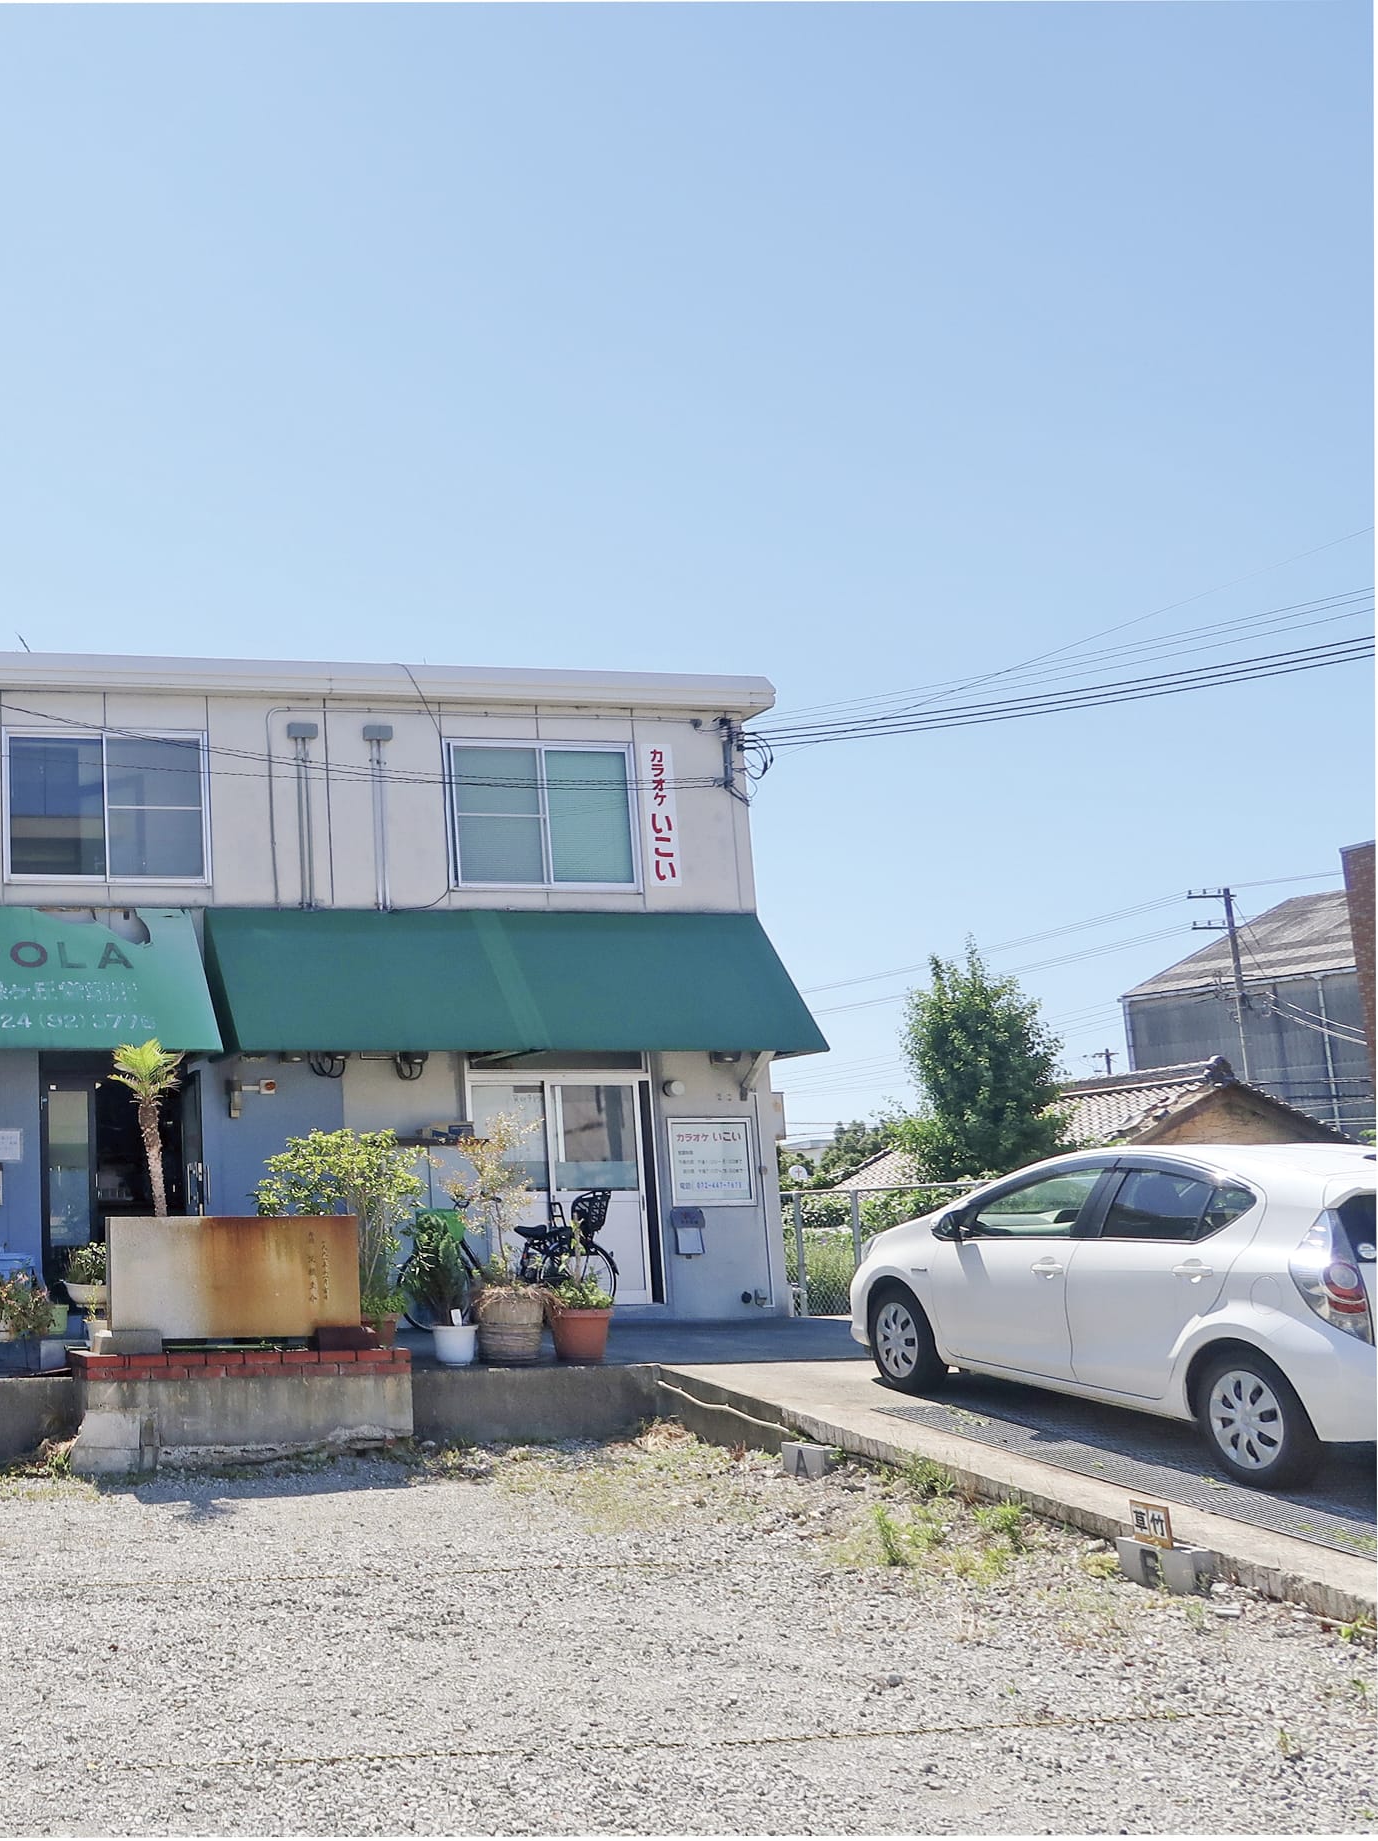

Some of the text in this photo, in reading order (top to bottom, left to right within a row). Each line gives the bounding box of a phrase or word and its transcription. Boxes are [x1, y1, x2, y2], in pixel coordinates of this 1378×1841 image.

[650, 749, 676, 881] カラオケ いこい
[676, 1131, 741, 1142] カラオケ いこい
[795, 1449, 810, 1479] A
[1133, 1510, 1165, 1537] 草竹
